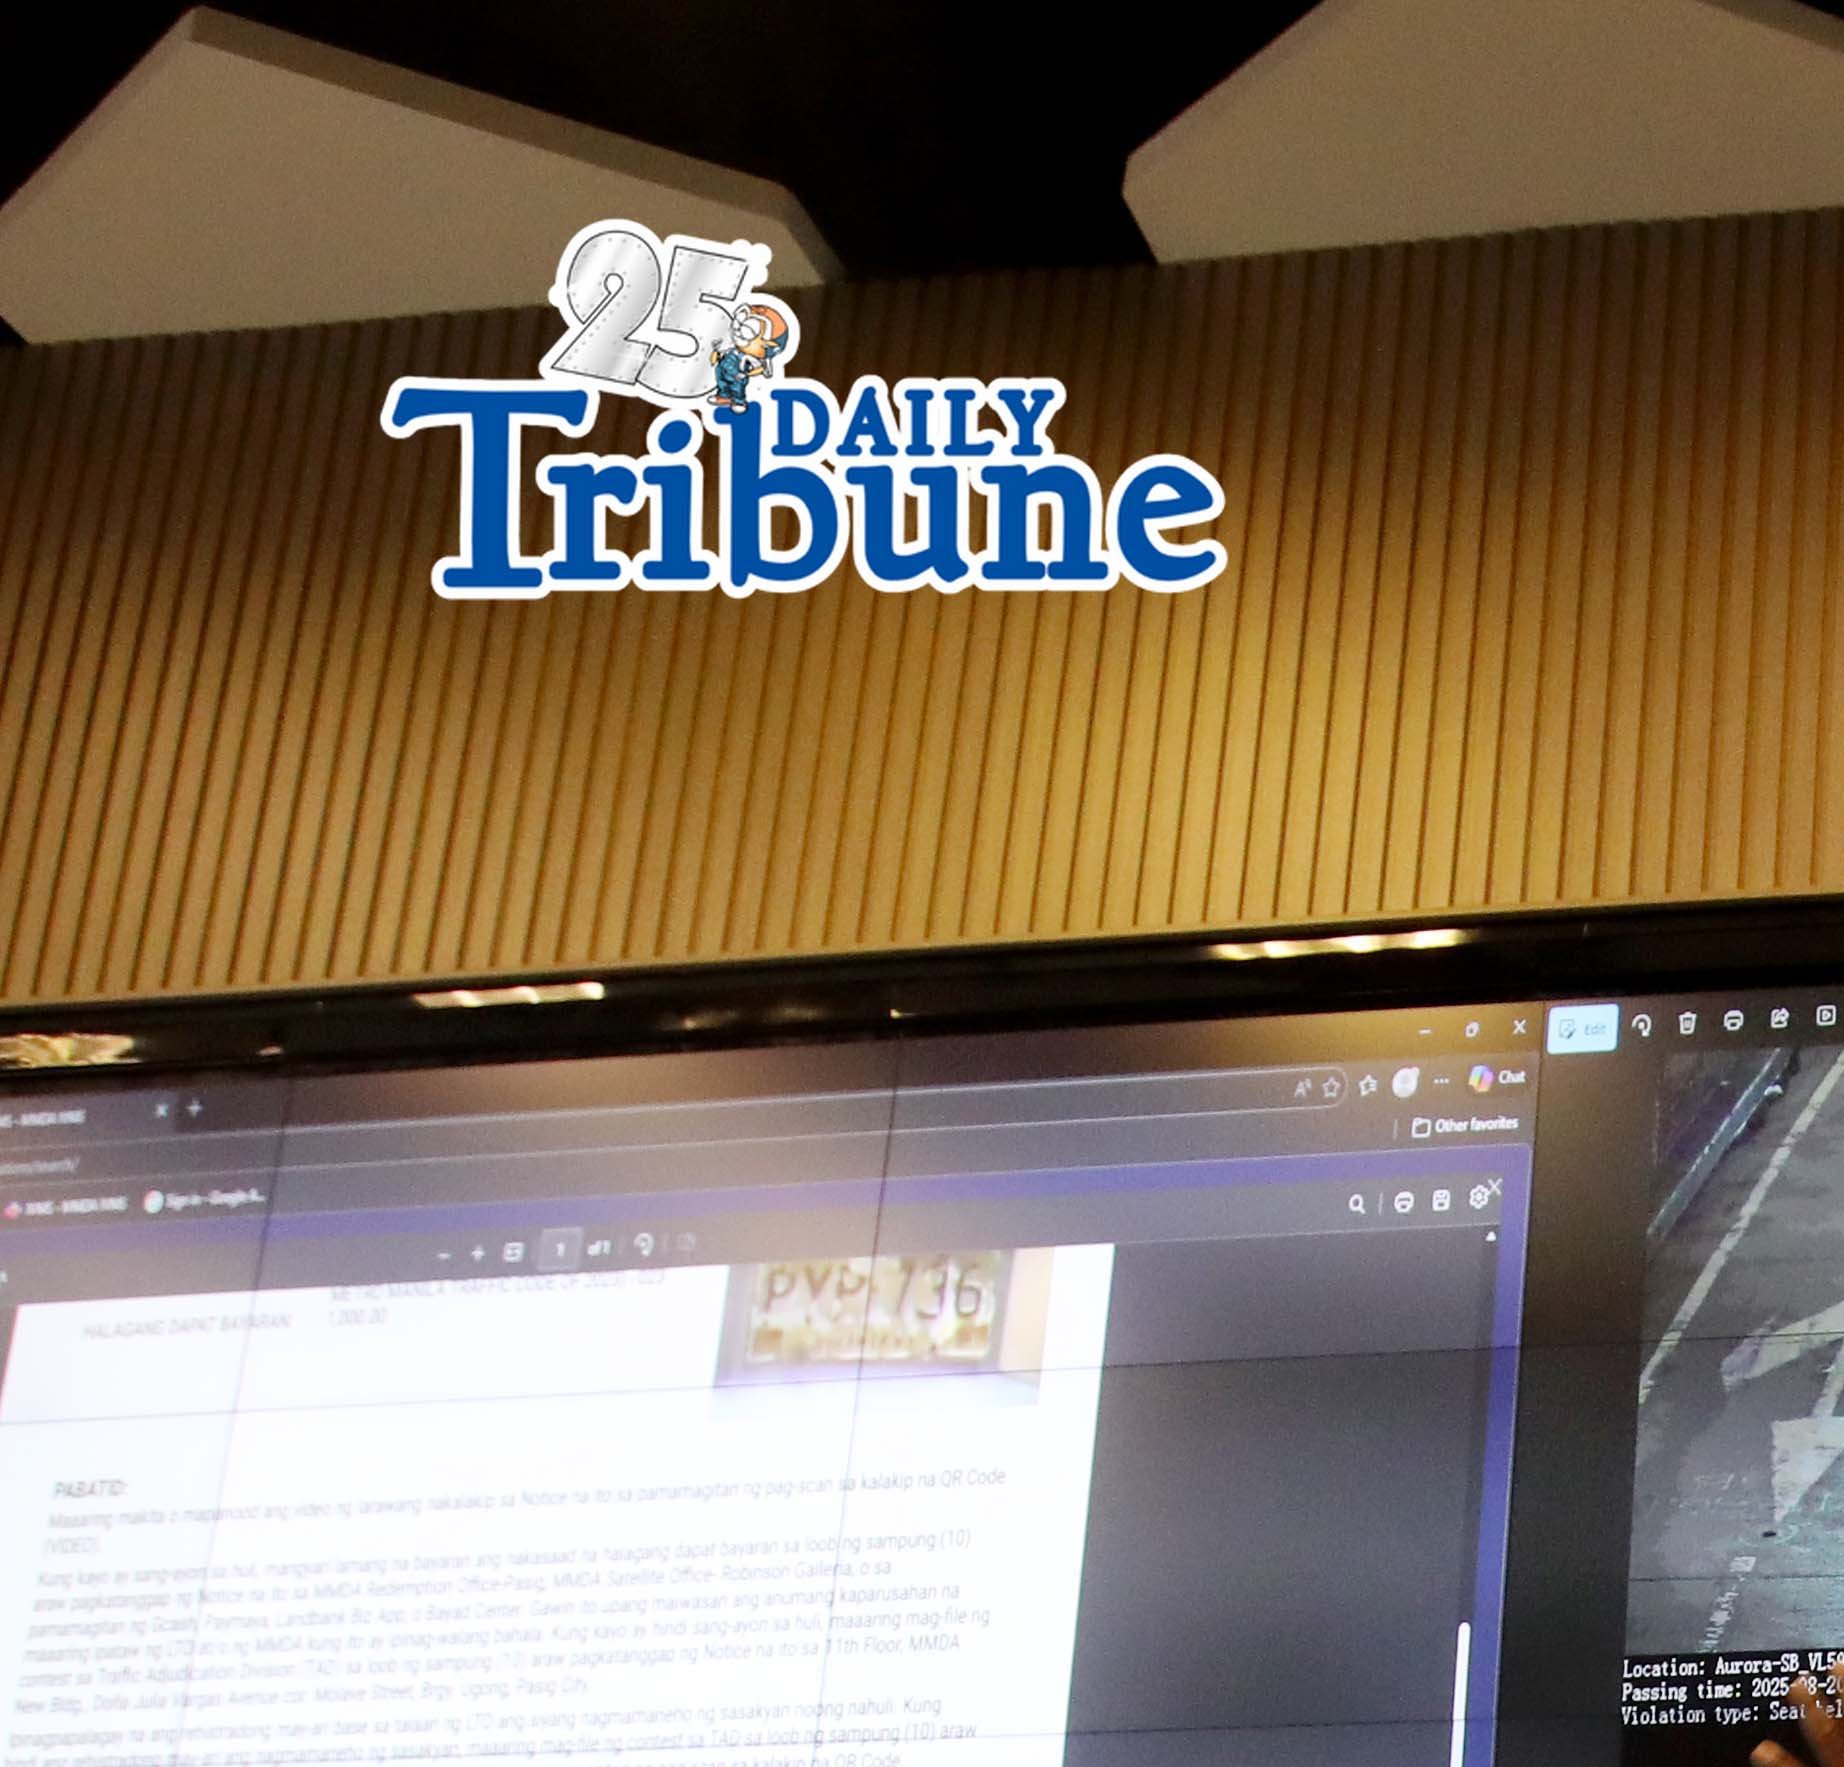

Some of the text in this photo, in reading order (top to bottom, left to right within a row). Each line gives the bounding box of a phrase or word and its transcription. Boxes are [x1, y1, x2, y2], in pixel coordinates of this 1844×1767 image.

[1498, 1069, 1526, 1086] Chat
[1435, 1114, 1519, 1133] Other favorites
[1623, 1658, 1705, 1678] Location:
[1622, 1681, 1688, 1703] Passing
[1696, 1679, 1741, 1699] time:
[1621, 1705, 1705, 1727] Violation
[1714, 1703, 1759, 1725] type:
